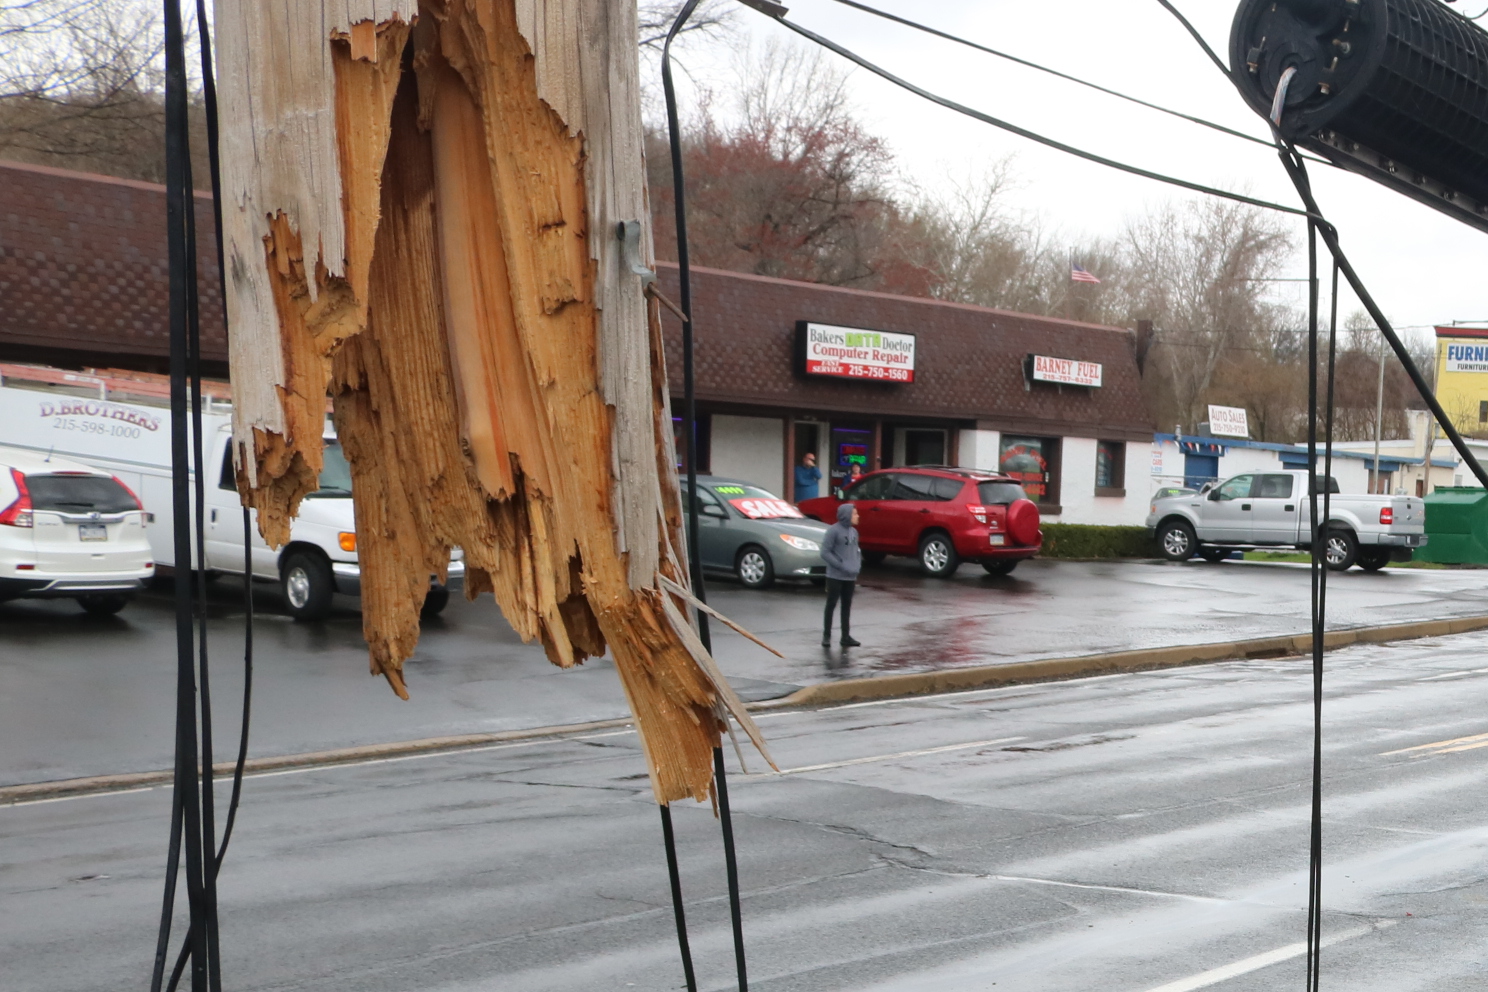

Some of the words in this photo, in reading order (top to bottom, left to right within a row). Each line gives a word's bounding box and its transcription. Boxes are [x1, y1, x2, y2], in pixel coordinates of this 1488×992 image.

[810, 328, 844, 345] Bakers
[845, 332, 881, 348] DATA
[882, 336, 913, 353] Doctor
[813, 343, 869, 360] Computer
[872, 349, 909, 365] Repair
[811, 365, 844, 373] SERVICE
[848, 364, 908, 381] 215-750-1560
[1036, 356, 1073, 375] BARNEY
[1077, 362, 1099, 379] FUEL
[39, 401, 161, 432] D.BROTHERS
[53, 417, 141, 439] 215-598-1000
[741, 500, 804, 518] SALE
